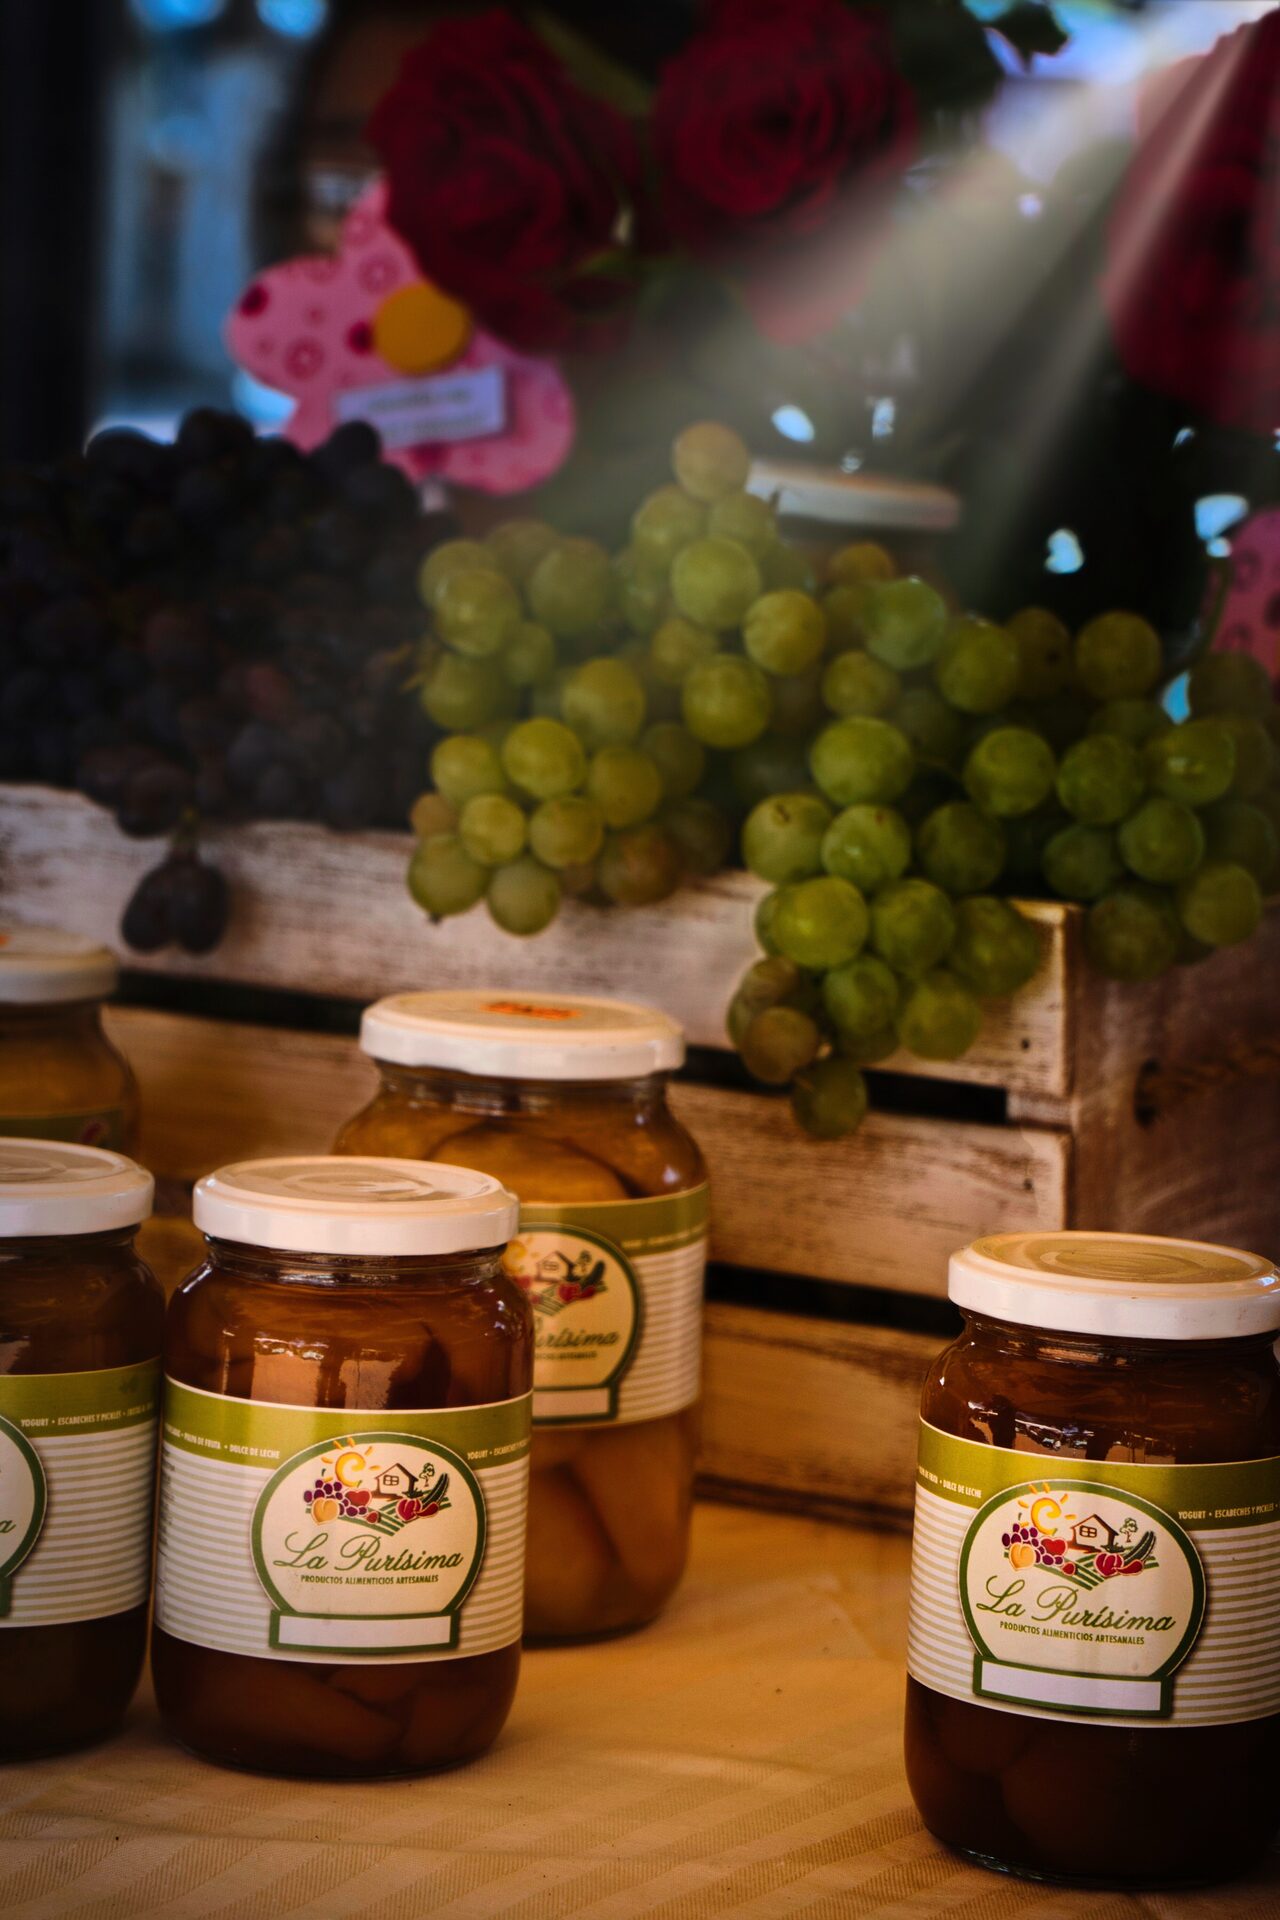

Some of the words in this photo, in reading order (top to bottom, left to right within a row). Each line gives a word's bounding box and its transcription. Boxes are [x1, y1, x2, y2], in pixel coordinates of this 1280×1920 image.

[21, 1418, 49, 1428] YOGURT
[57, 1413, 96, 1426] ESCABECHES
[229, 1444, 250, 1456] DULCE
[250, 1446, 259, 1457] DE
[260, 1448, 281, 1460] LECHE
[942, 1479, 957, 1492] DULCE
[957, 1484, 965, 1495] DE
[965, 1486, 982, 1499] LECHE
[1178, 1510, 1206, 1520] YOGURT
[1214, 1506, 1251, 1519] ESCABECHES
[273, 1531, 329, 1570] La
[334, 1534, 464, 1572] Purísima
[300, 1574, 344, 1585] PRODUCTOS
[345, 1576, 394, 1586] ALIMENTICIOS
[395, 1574, 439, 1585] ARTESANALES
[976, 1575, 1026, 1617] La
[1031, 1585, 1177, 1632] Purísima
[999, 1620, 1041, 1636] PRODUCTOS
[1041, 1627, 1094, 1643] ALIMENTICIOS
[1095, 1633, 1145, 1646] ARTESANALES
